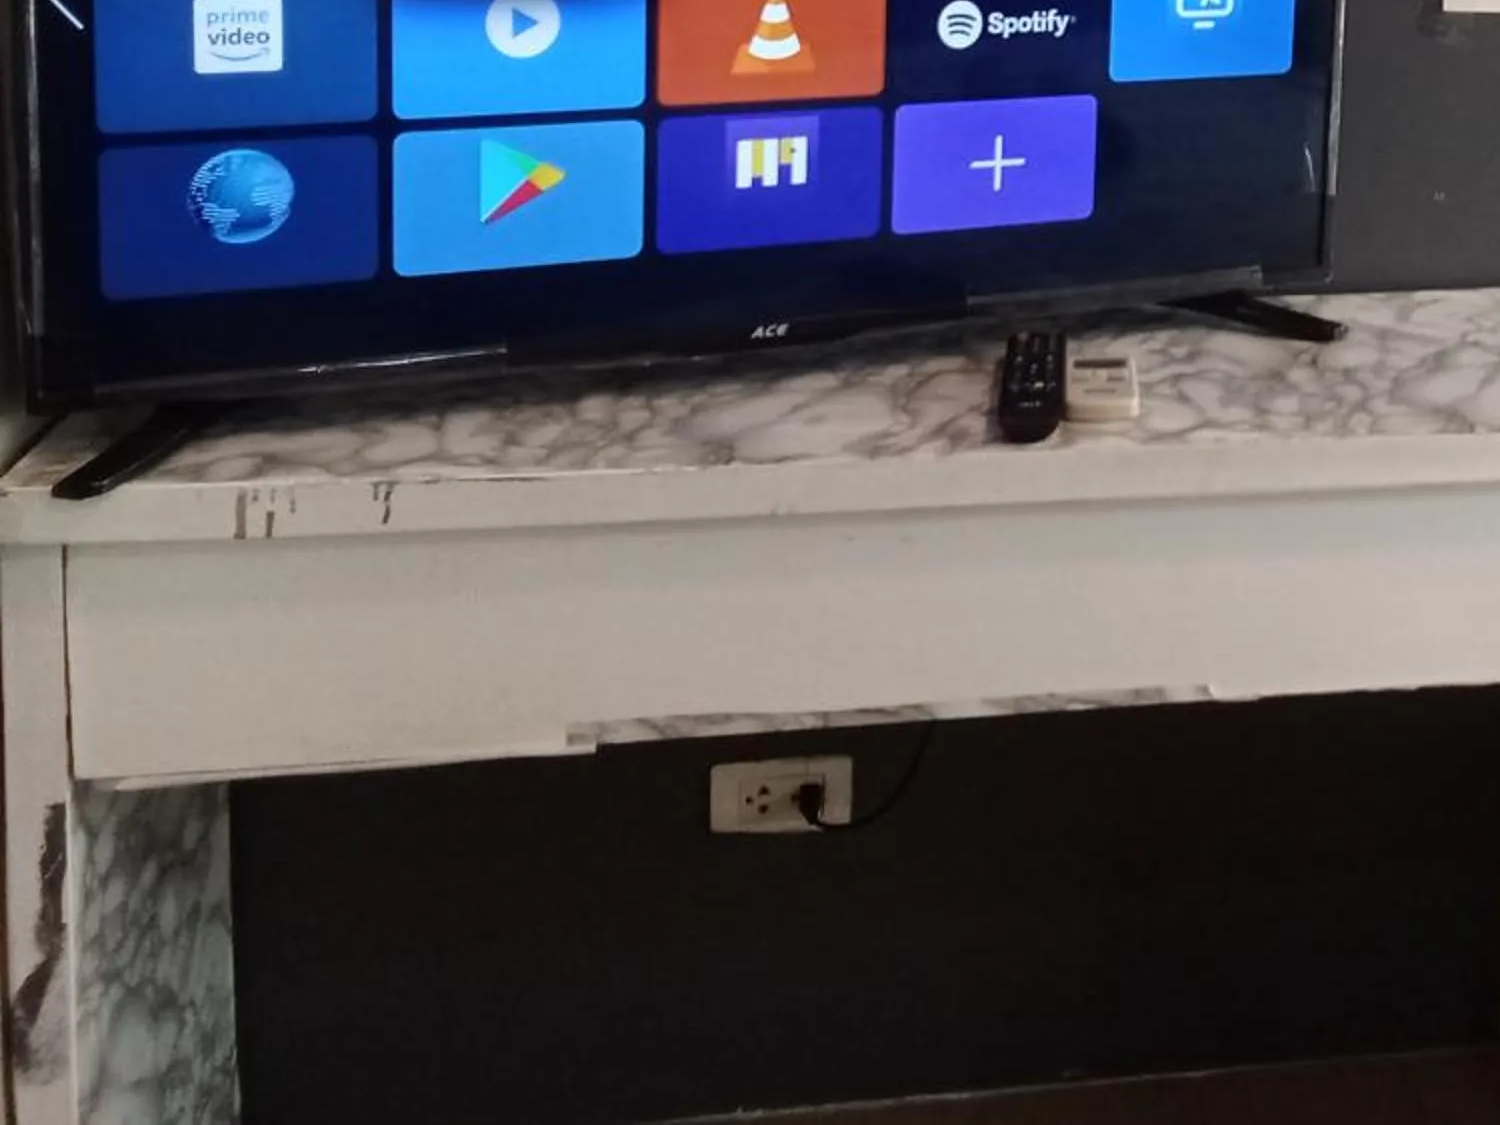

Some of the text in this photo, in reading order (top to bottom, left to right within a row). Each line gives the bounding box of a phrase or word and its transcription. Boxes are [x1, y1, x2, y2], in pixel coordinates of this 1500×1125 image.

[206, 7, 270, 27] prime
[987, 7, 1070, 39] Spotify
[207, 27, 271, 46] video
[750, 322, 789, 340] ACE
